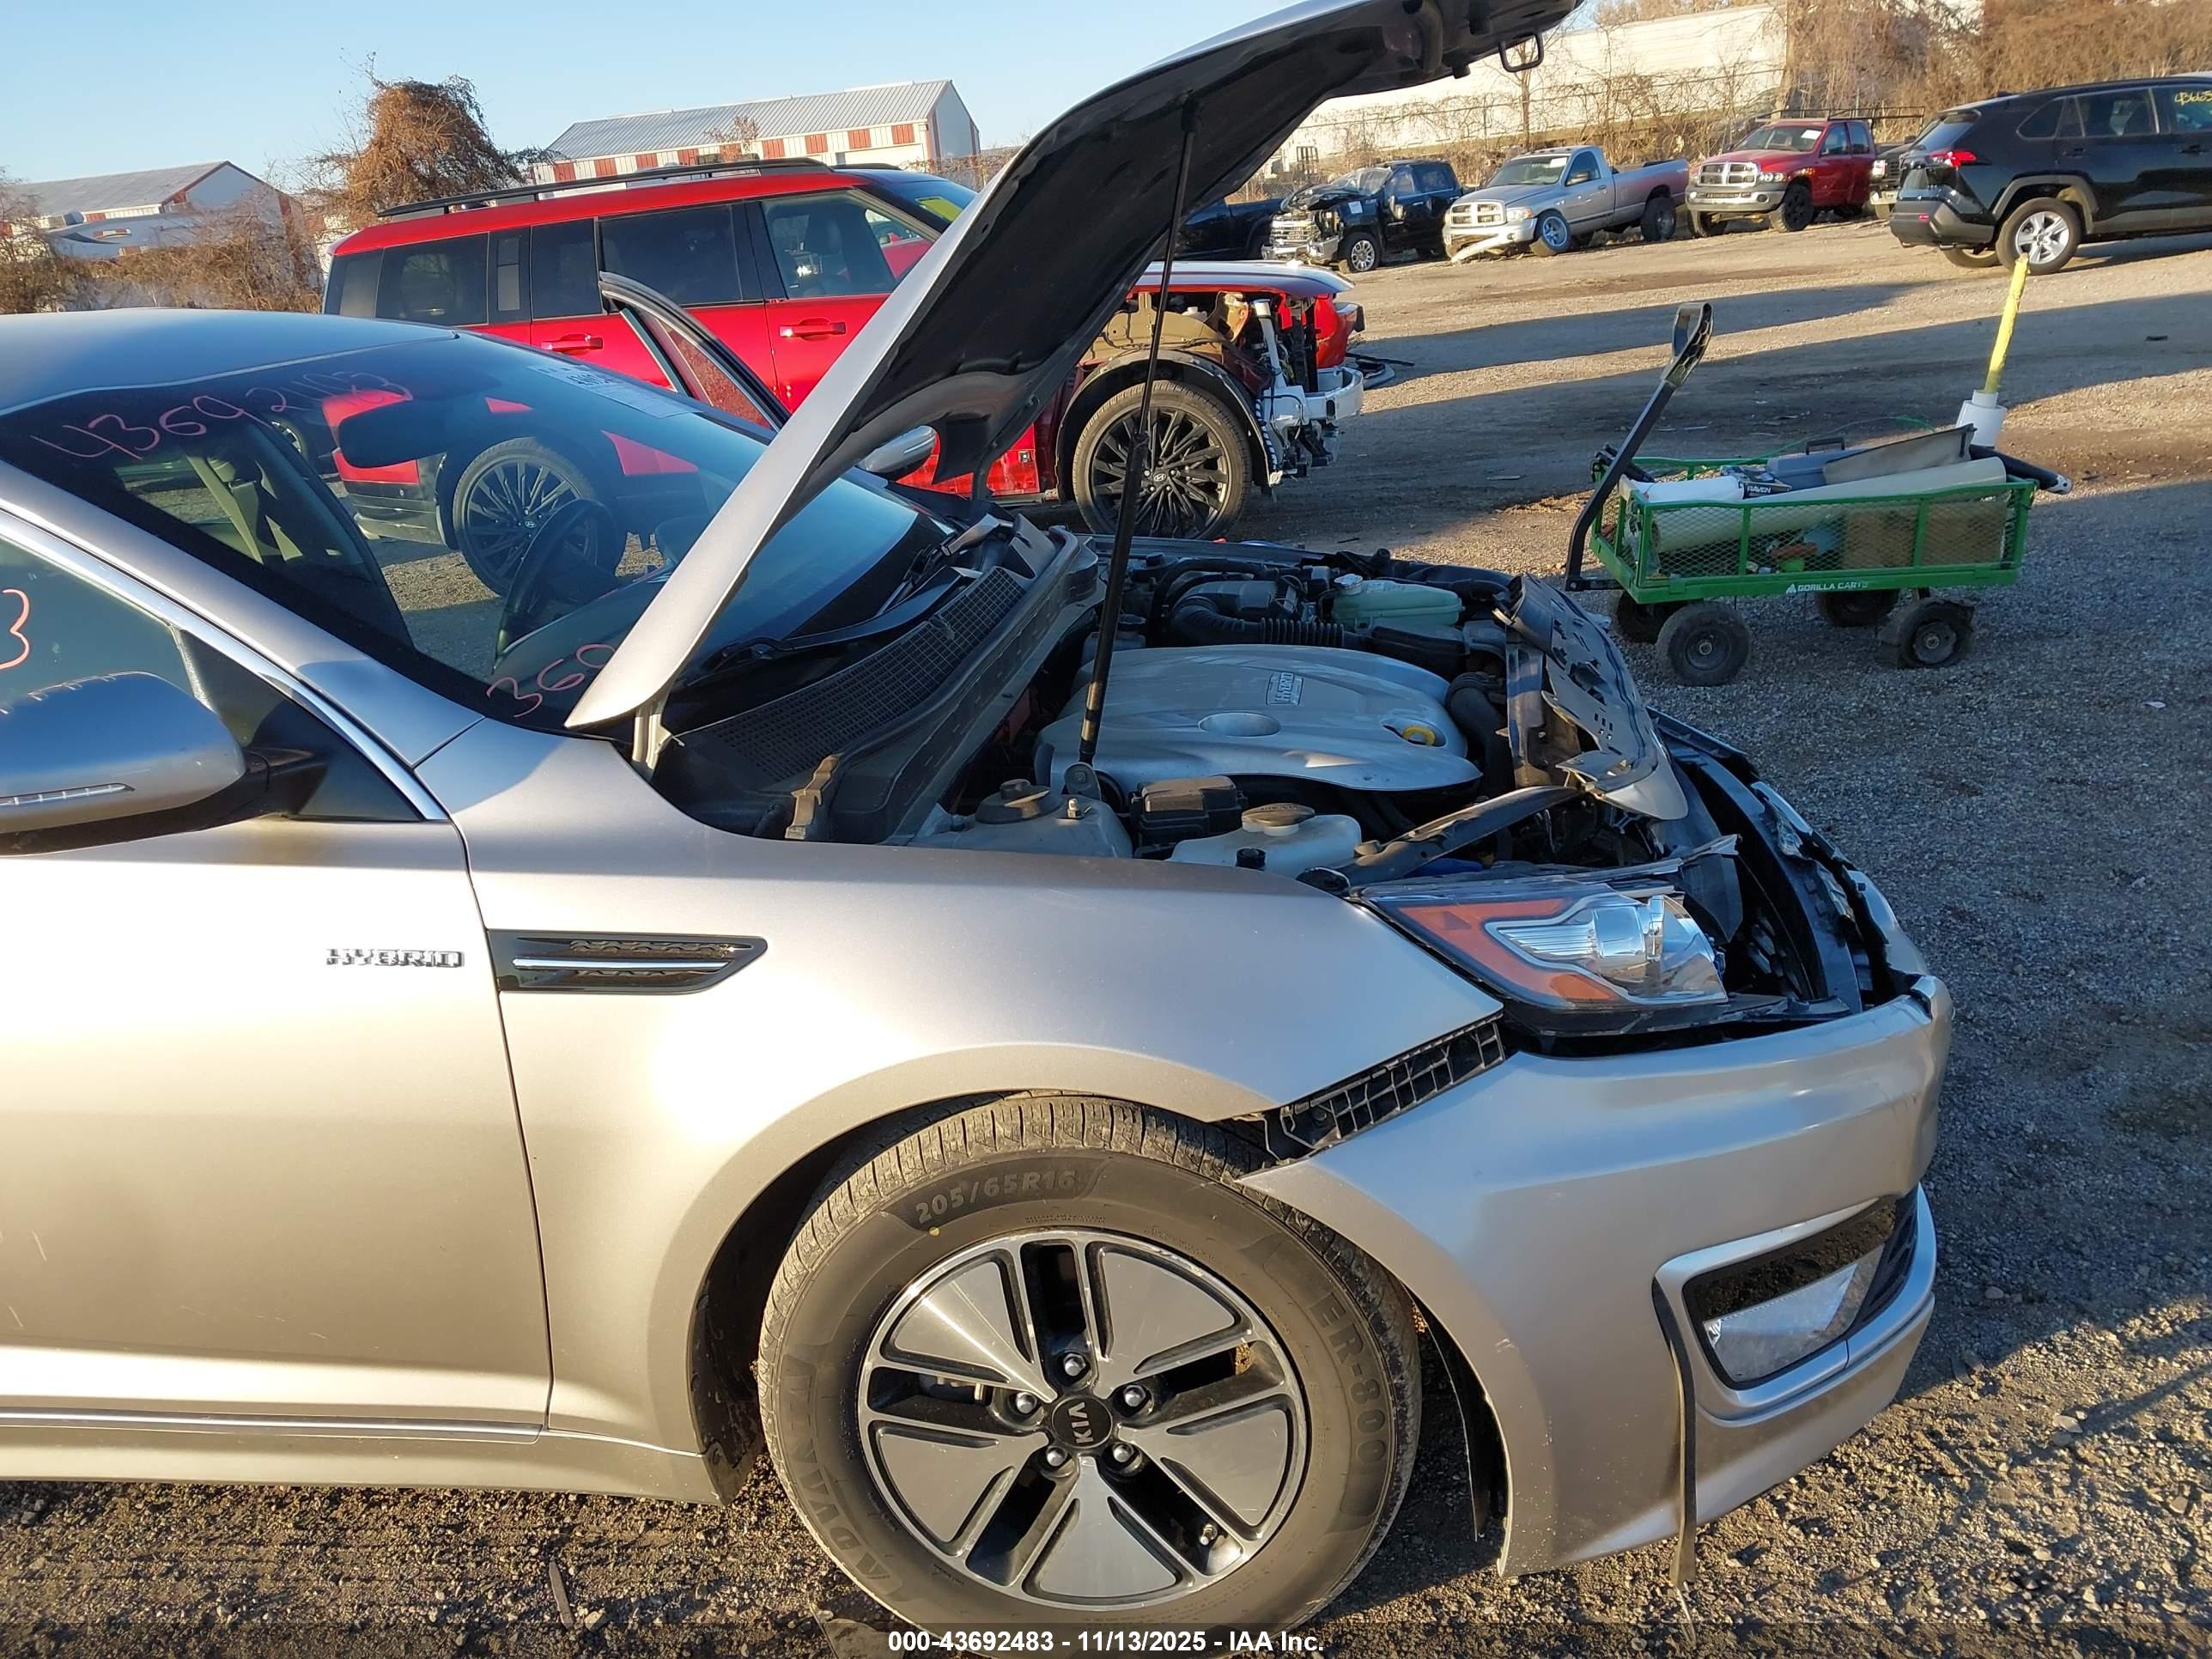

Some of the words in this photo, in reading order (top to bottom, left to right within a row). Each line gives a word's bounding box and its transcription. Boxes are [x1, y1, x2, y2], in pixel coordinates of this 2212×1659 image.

[1747, 485, 1771, 494] RAVEN
[1797, 583, 1835, 592] GORILLA
[325, 948, 465, 968] HYBRID
[915, 1170, 1077, 1224] 205/65R16
[1308, 1291, 1388, 1464] ER-800
[1068, 1401, 1094, 1444] KIA
